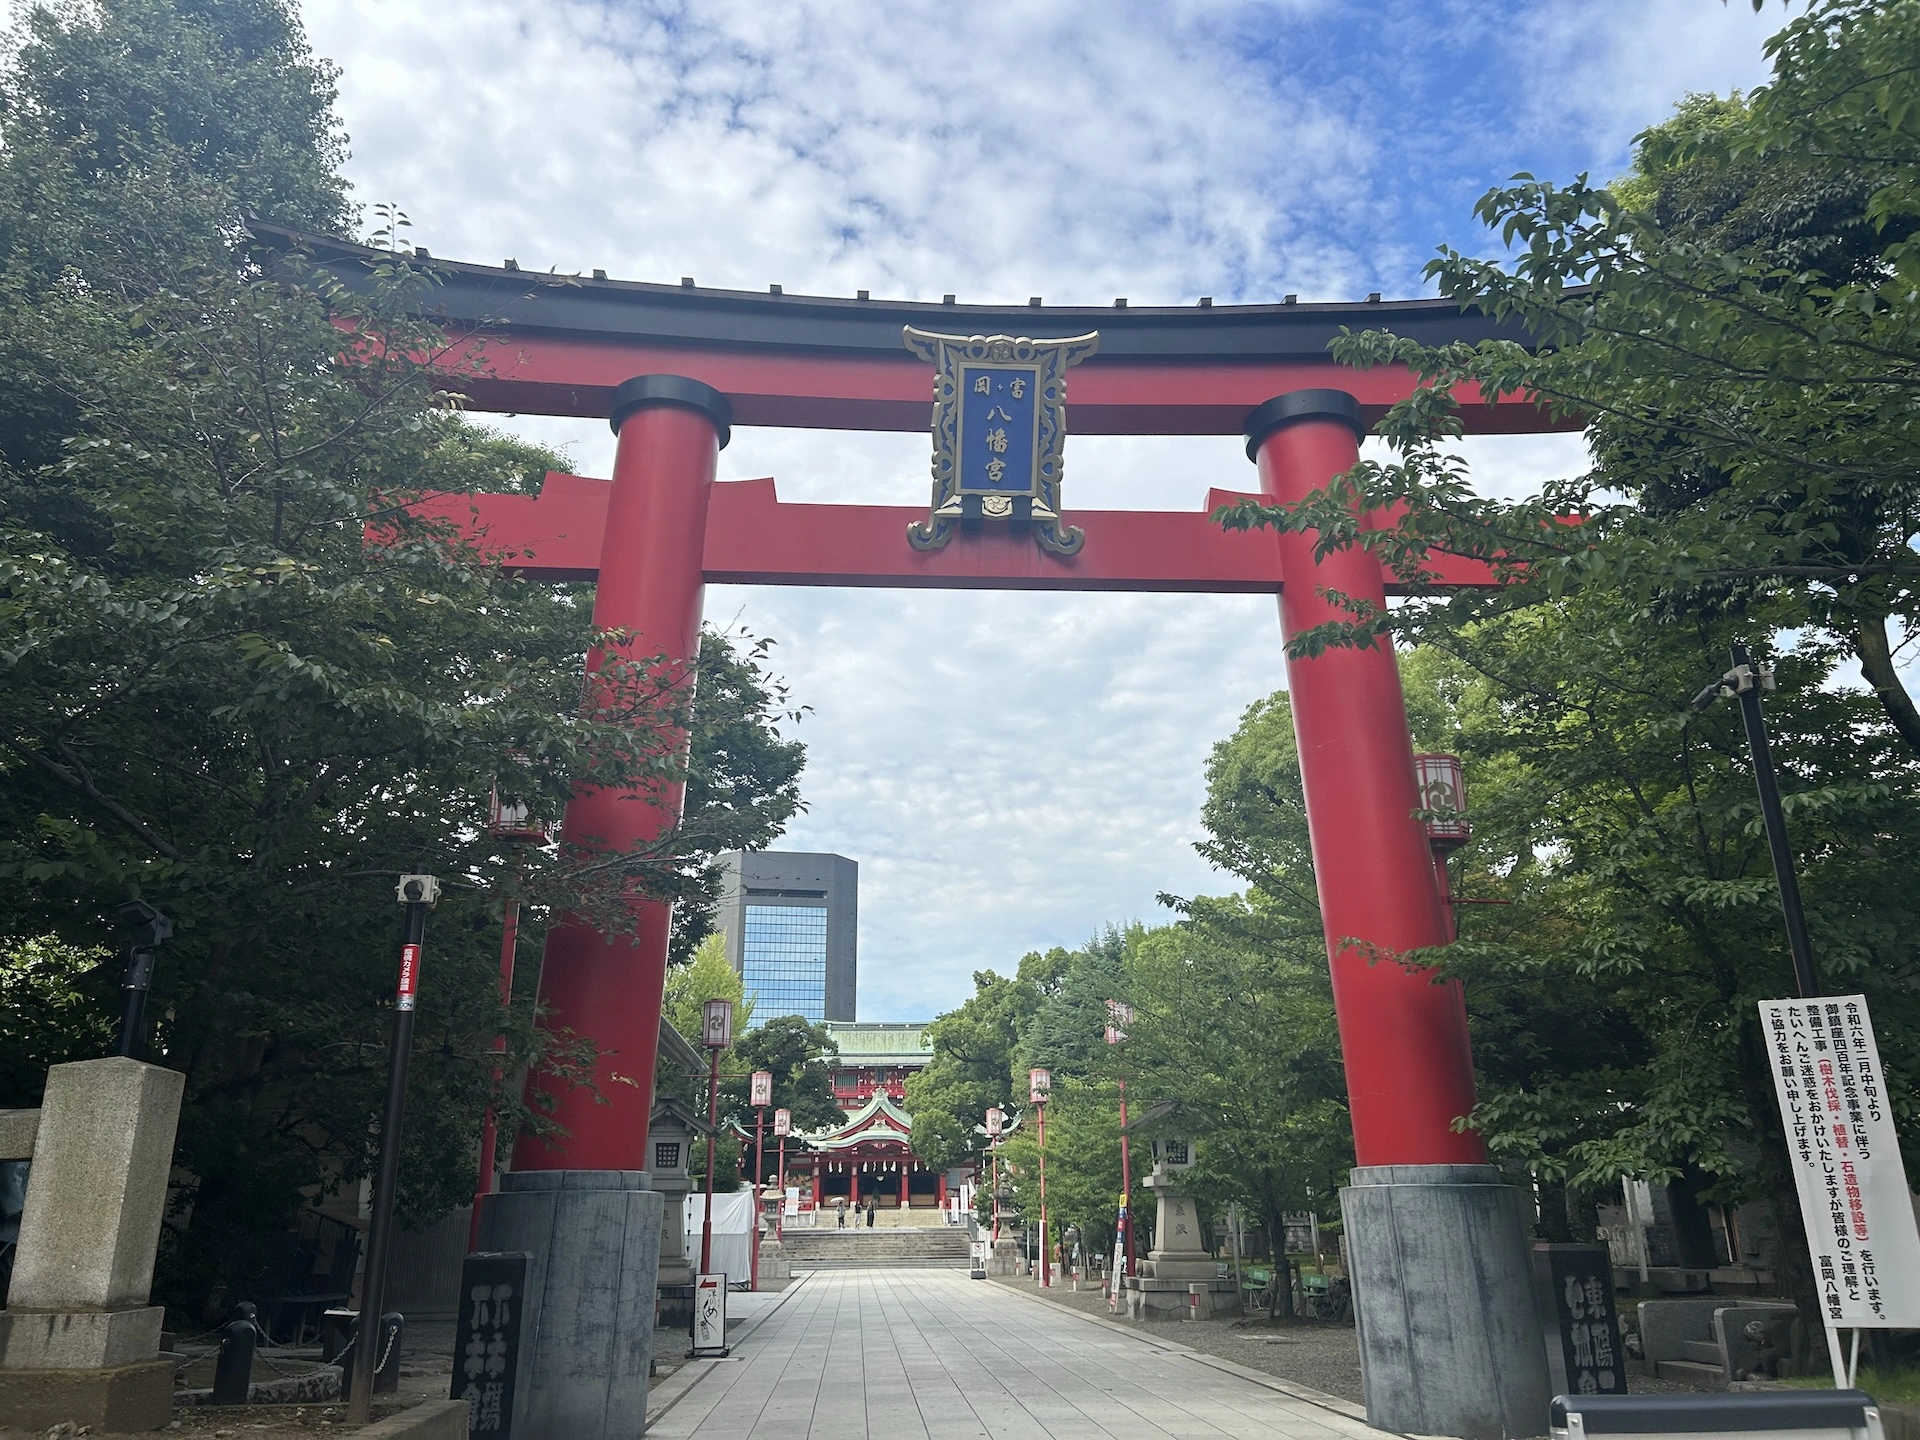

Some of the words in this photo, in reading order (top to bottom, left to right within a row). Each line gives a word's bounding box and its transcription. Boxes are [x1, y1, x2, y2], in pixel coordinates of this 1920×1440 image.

[985, 405, 1012, 482] 八幡宮
[1770, 1008, 1814, 1168] ご協力をお願い申し上げます。
[1825, 1003, 1871, 1160] 御鎮座四百年記念事業に伴う
[1844, 1002, 1881, 1122] 令和六年二月中旬より
[1788, 1006, 1861, 1301] たいへんご迷惑をおかけいたしますが皆様のご理解と
[1818, 1255, 1843, 1320] 富岡八幡宮
